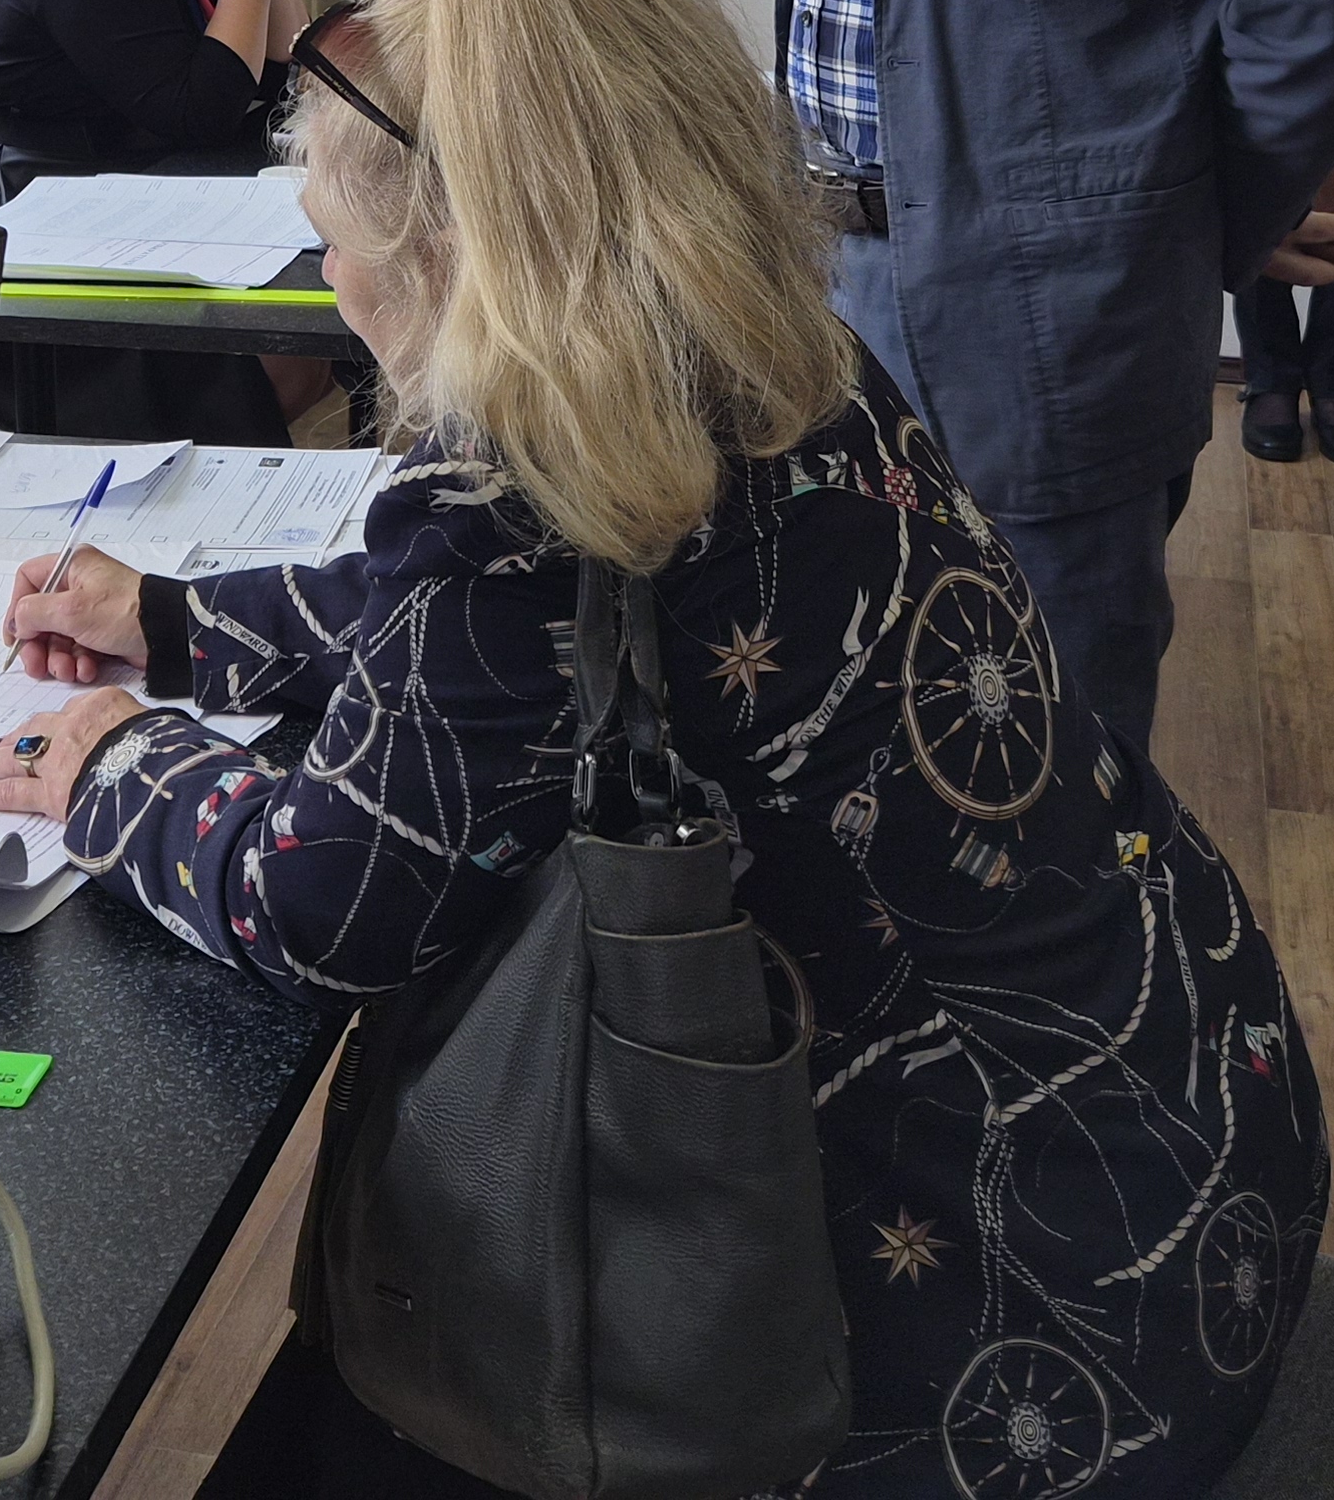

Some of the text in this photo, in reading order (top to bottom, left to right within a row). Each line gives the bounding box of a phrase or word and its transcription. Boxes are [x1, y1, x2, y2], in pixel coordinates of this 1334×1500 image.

[217, 613, 269, 653] WINDWARD
[800, 654, 857, 744] ON THE WIND
